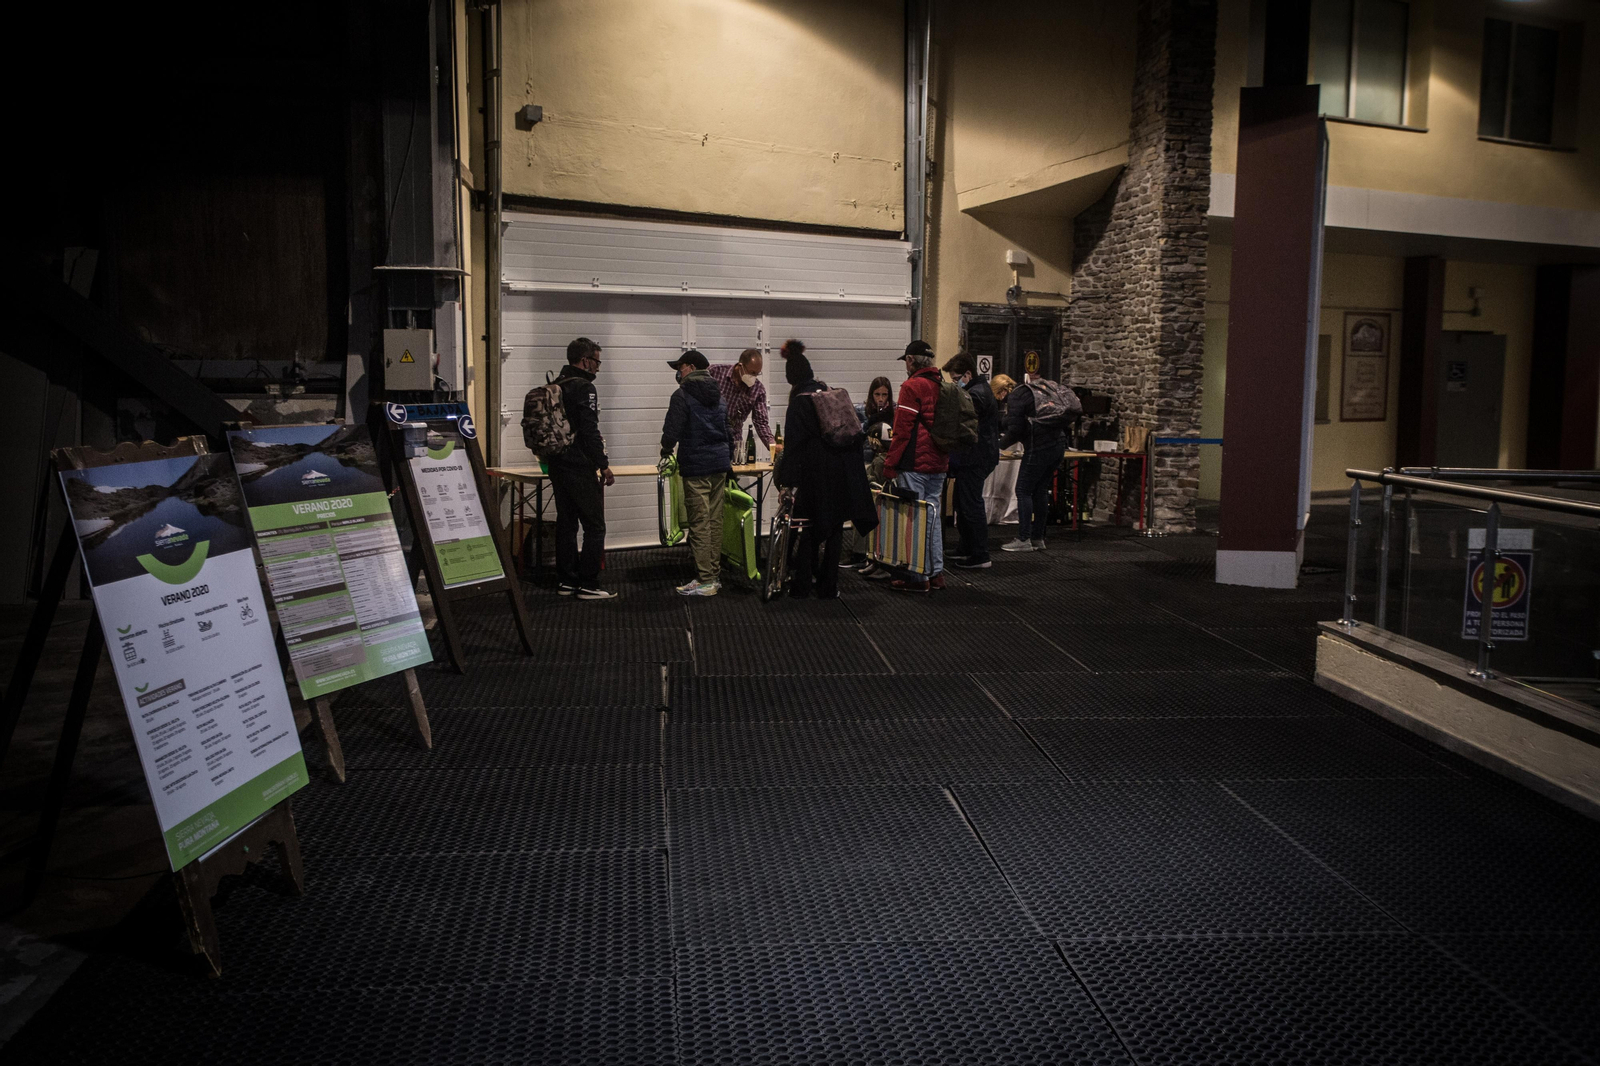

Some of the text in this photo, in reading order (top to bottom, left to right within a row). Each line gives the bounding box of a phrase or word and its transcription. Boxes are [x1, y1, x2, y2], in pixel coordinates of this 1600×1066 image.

[418, 405, 463, 416] BAJADA
[292, 498, 352, 513] VERANO 2020
[161, 584, 209, 606] VERANO 2020
[139, 689, 166, 705] ACTIVIDADES
[166, 682, 182, 693] VERANO
[175, 823, 194, 841] SIERRA
[178, 832, 197, 850] PURA
